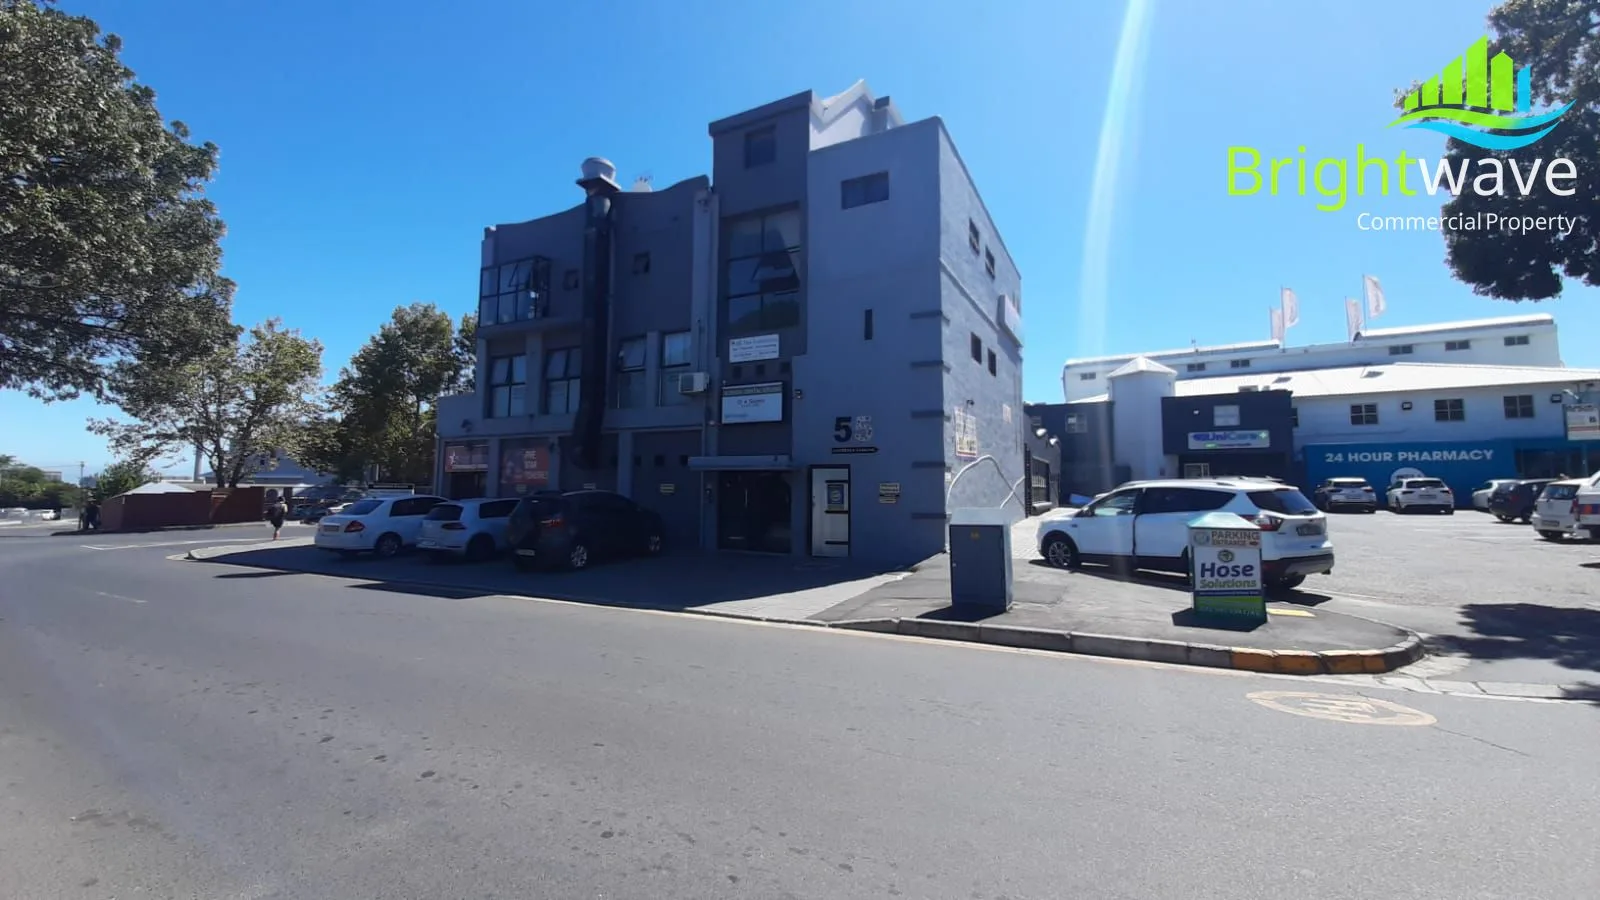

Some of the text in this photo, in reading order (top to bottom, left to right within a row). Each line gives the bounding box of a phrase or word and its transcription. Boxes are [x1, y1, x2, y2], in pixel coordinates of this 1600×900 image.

[1325, 449, 1494, 463] 24 HOUR PHARMACY
[1211, 530, 1260, 540] PARKING
[1200, 562, 1255, 578] Hose
[1199, 578, 1258, 589] Solutions
